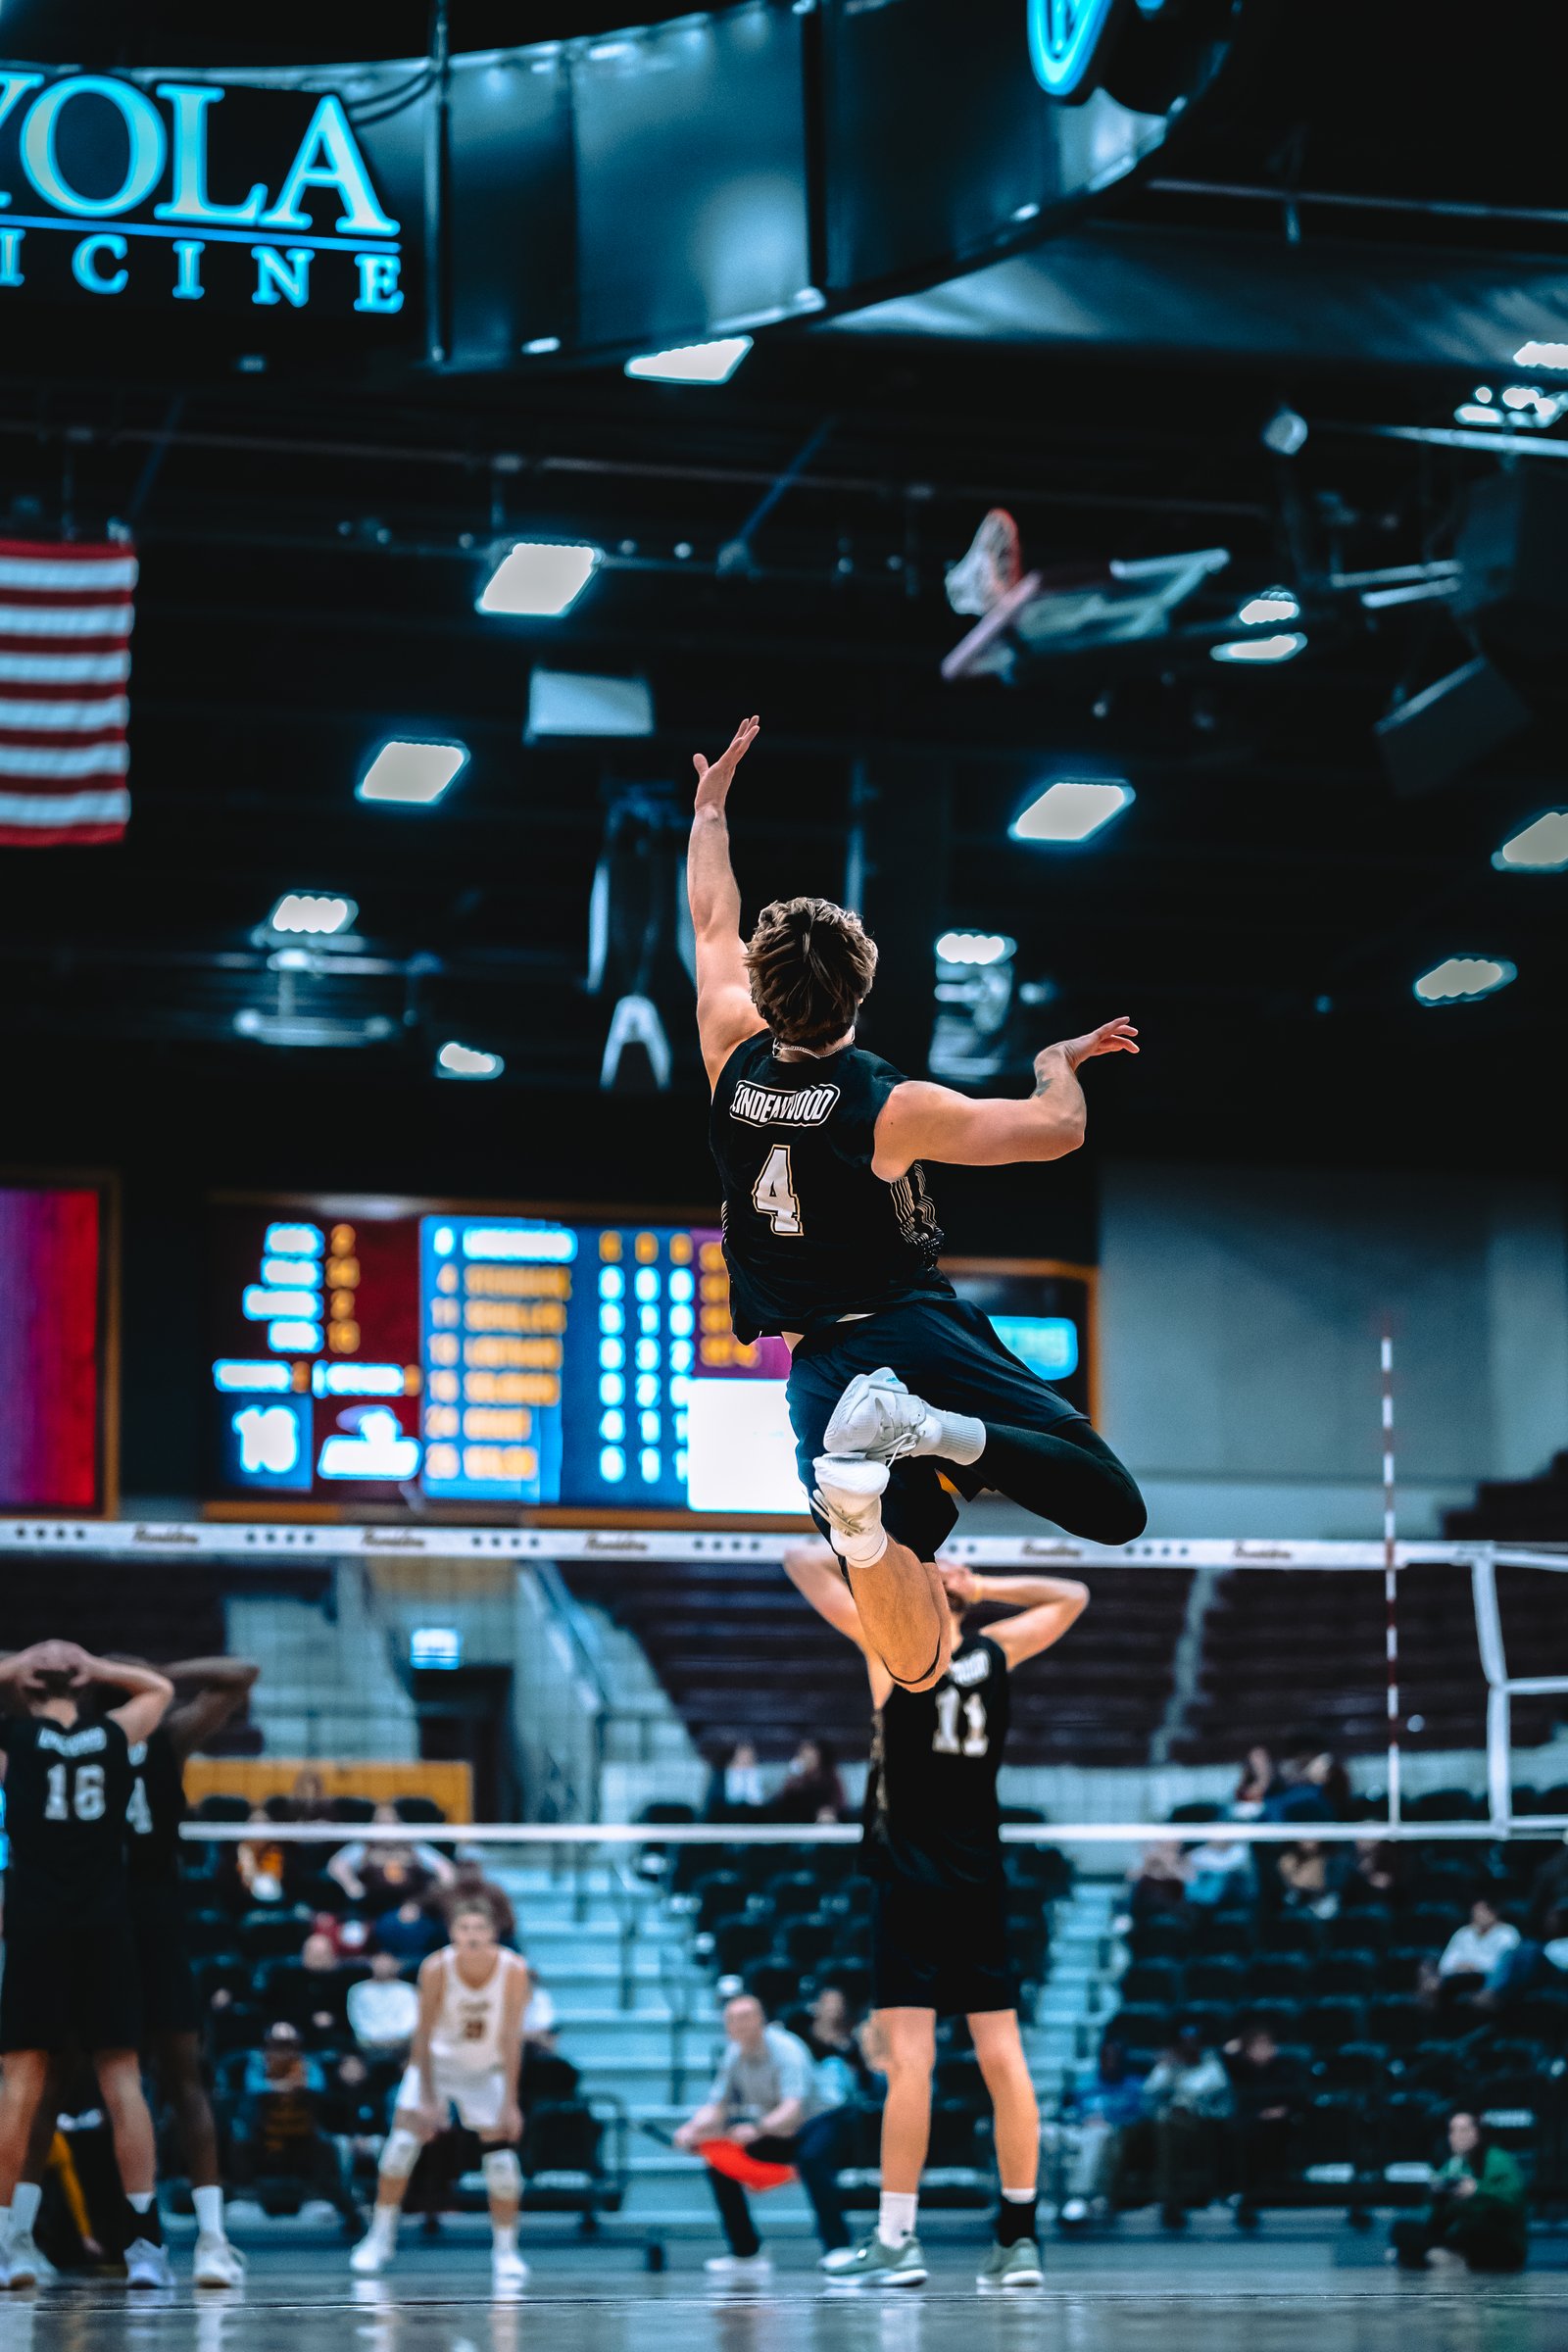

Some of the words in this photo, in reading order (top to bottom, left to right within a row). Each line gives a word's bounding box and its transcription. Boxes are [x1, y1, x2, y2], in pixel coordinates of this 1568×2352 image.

[752, 1144, 805, 1237] 4
[932, 1685, 990, 1758] 11
[45, 1763, 107, 1821] 16
